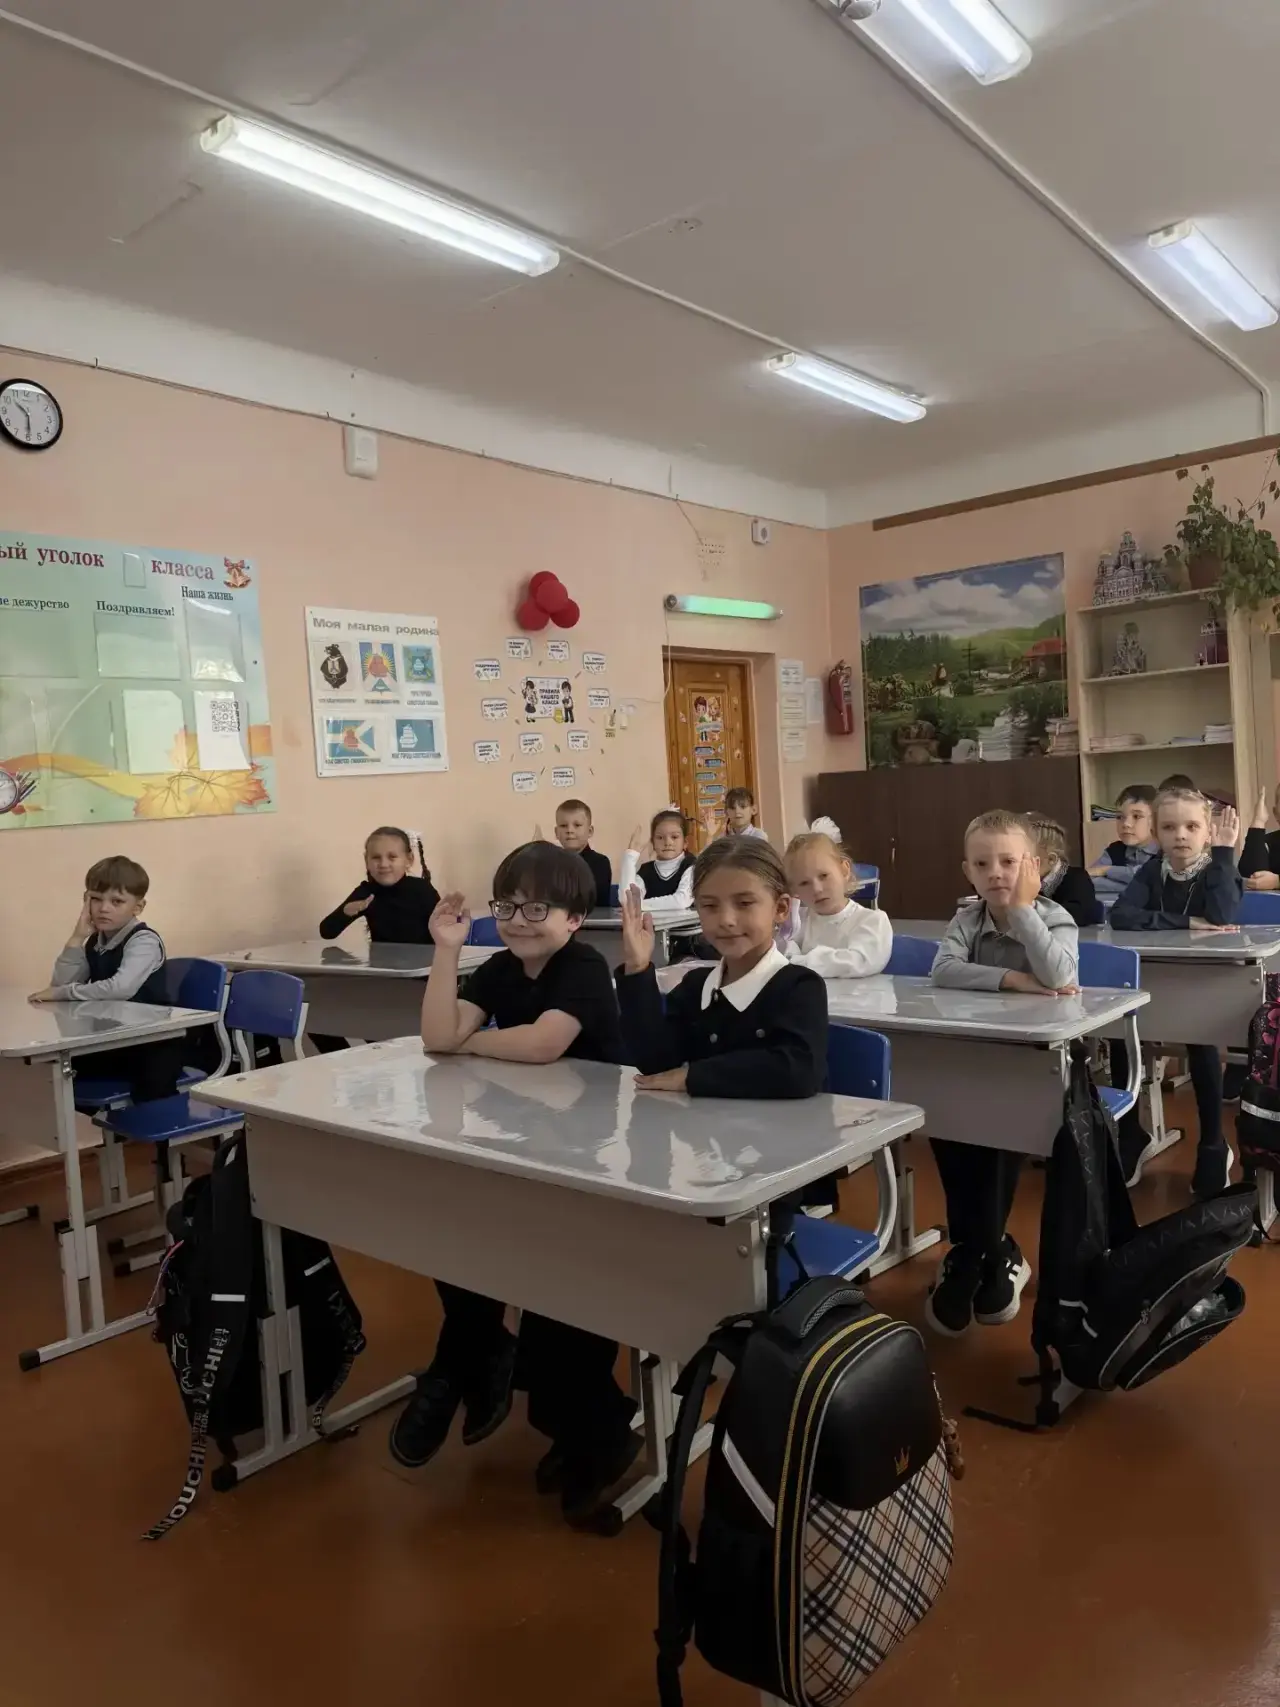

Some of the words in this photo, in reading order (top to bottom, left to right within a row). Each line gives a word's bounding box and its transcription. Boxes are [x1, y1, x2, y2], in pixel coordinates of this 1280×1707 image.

[12, 389, 19, 399] 11
[1, 406, 8, 415] 9
[44, 404, 50, 412] 2
[5, 418, 11, 427] 8
[47, 415, 53, 424] 3
[13, 427, 20, 436] 7
[44, 426, 50, 435] 4
[25, 433, 32, 441] 6
[36, 432, 42, 441] 5
[37, 548, 105, 568] уголок
[151, 559, 215, 581] класса
[181, 586, 206, 599] Наша
[207, 590, 234, 601] жизнь
[12, 598, 70, 610] дежурство
[96, 600, 175, 617] Поздравляем!
[313, 618, 341, 629] Моя
[348, 622, 390, 633] малая
[396, 625, 440, 636] родина
